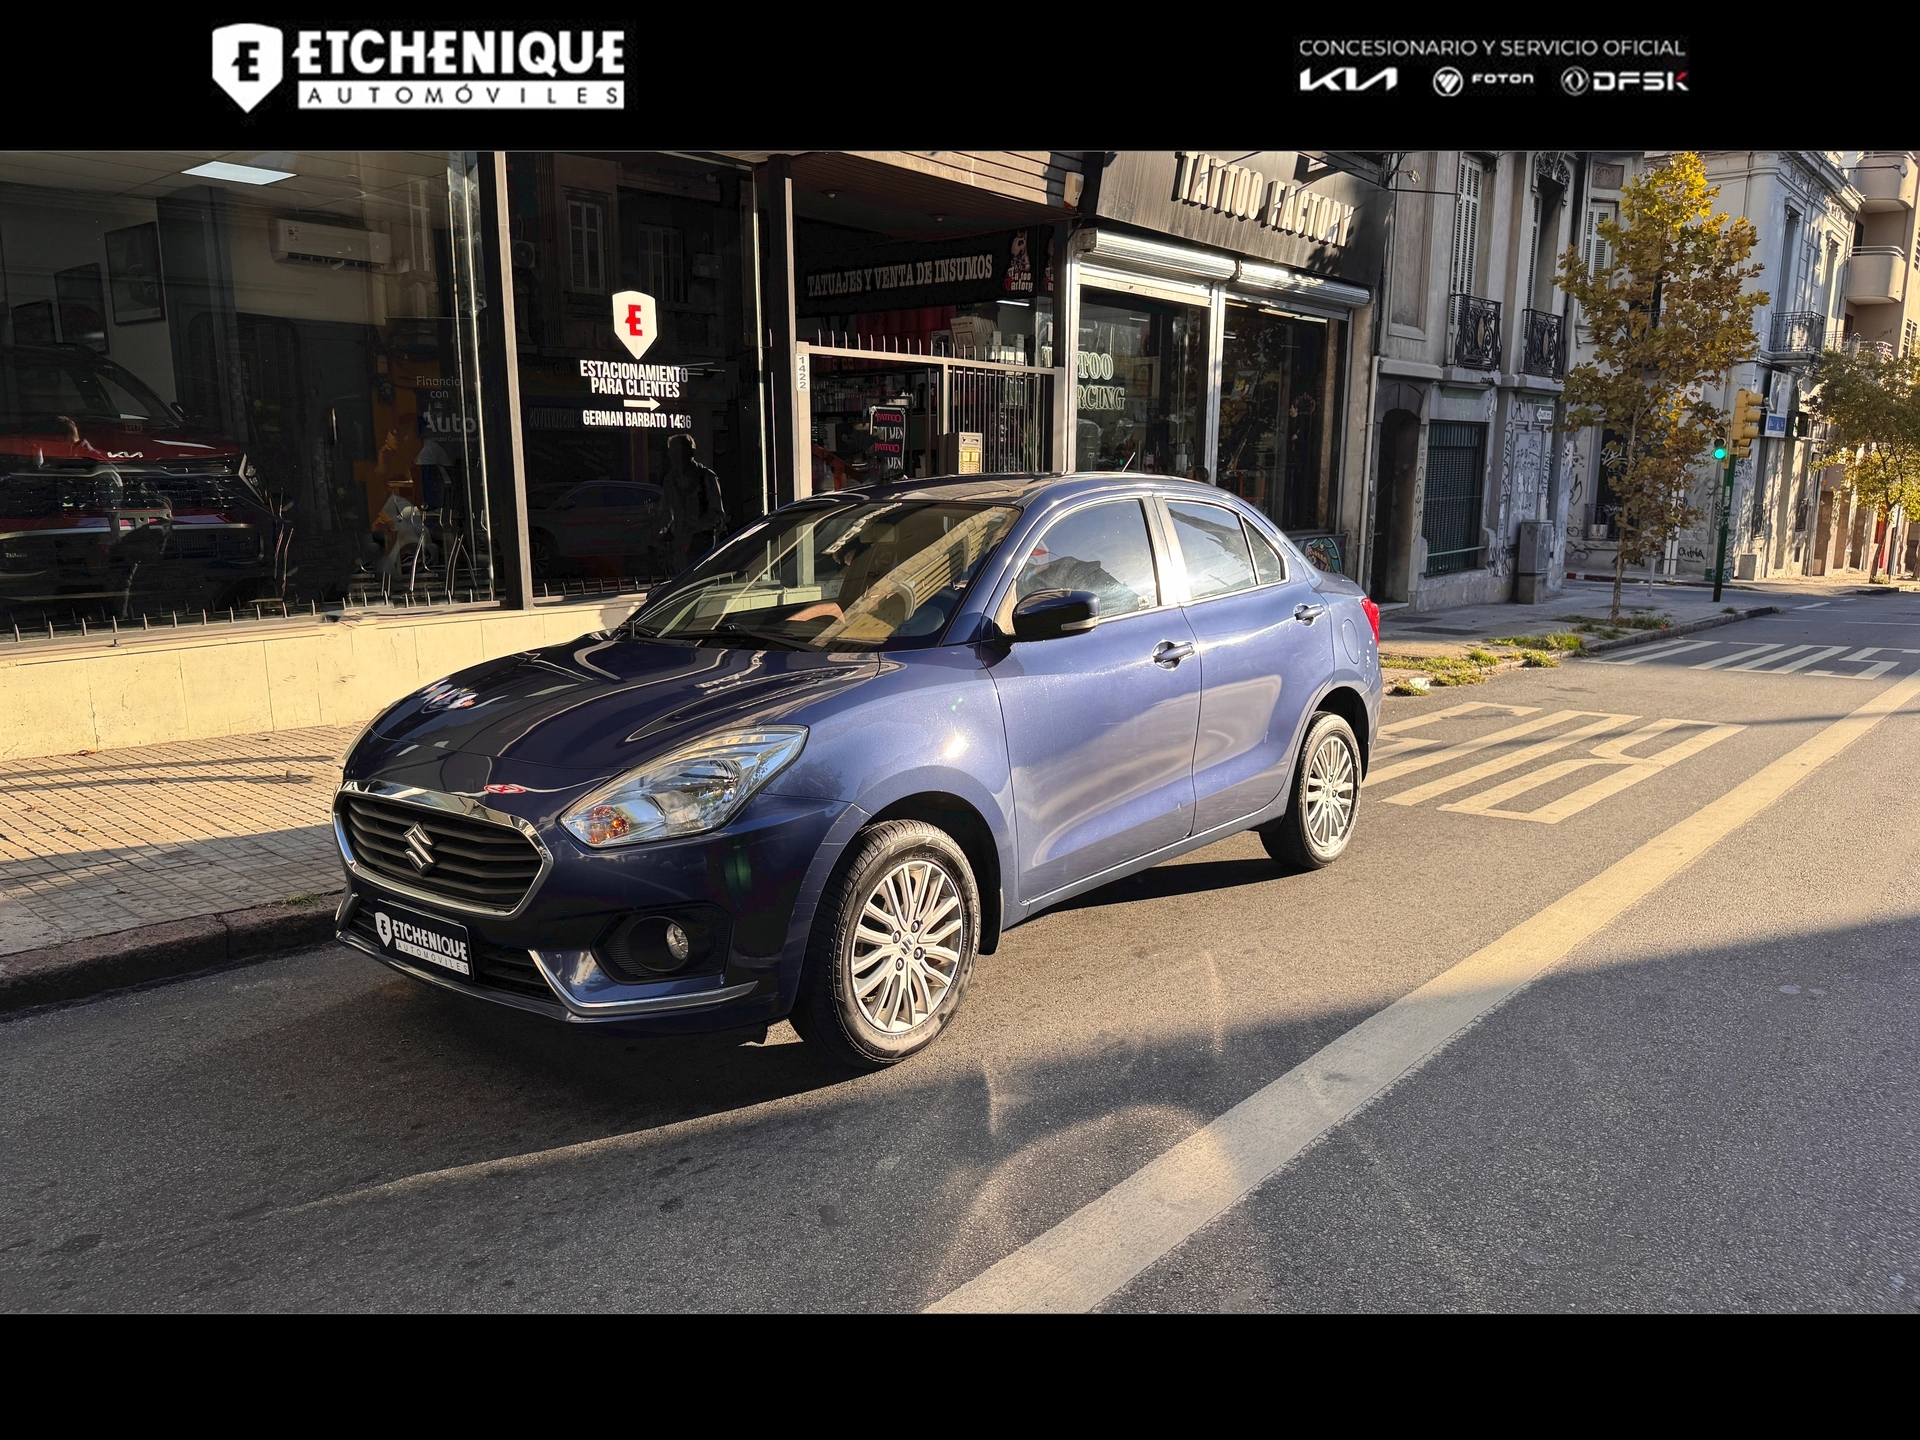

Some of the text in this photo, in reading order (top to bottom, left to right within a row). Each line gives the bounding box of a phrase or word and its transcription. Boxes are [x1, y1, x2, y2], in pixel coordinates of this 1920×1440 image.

[1178, 151, 1355, 247] TATTOO FACTORY
[807, 254, 993, 297] TATUAJES Y VENTA DE INSUMOS
[579, 359, 689, 383] ESTACIONAMIENTO
[798, 356, 806, 389] 1422
[1077, 351, 1114, 380] TOO
[430, 390, 449, 399] con
[590, 377, 680, 398] PARA CLIENTES
[582, 409, 692, 429] GERMAN BARBATO 1436
[107, 451, 144, 459] KIA
[392, 919, 468, 961] ETCHENIQUE
